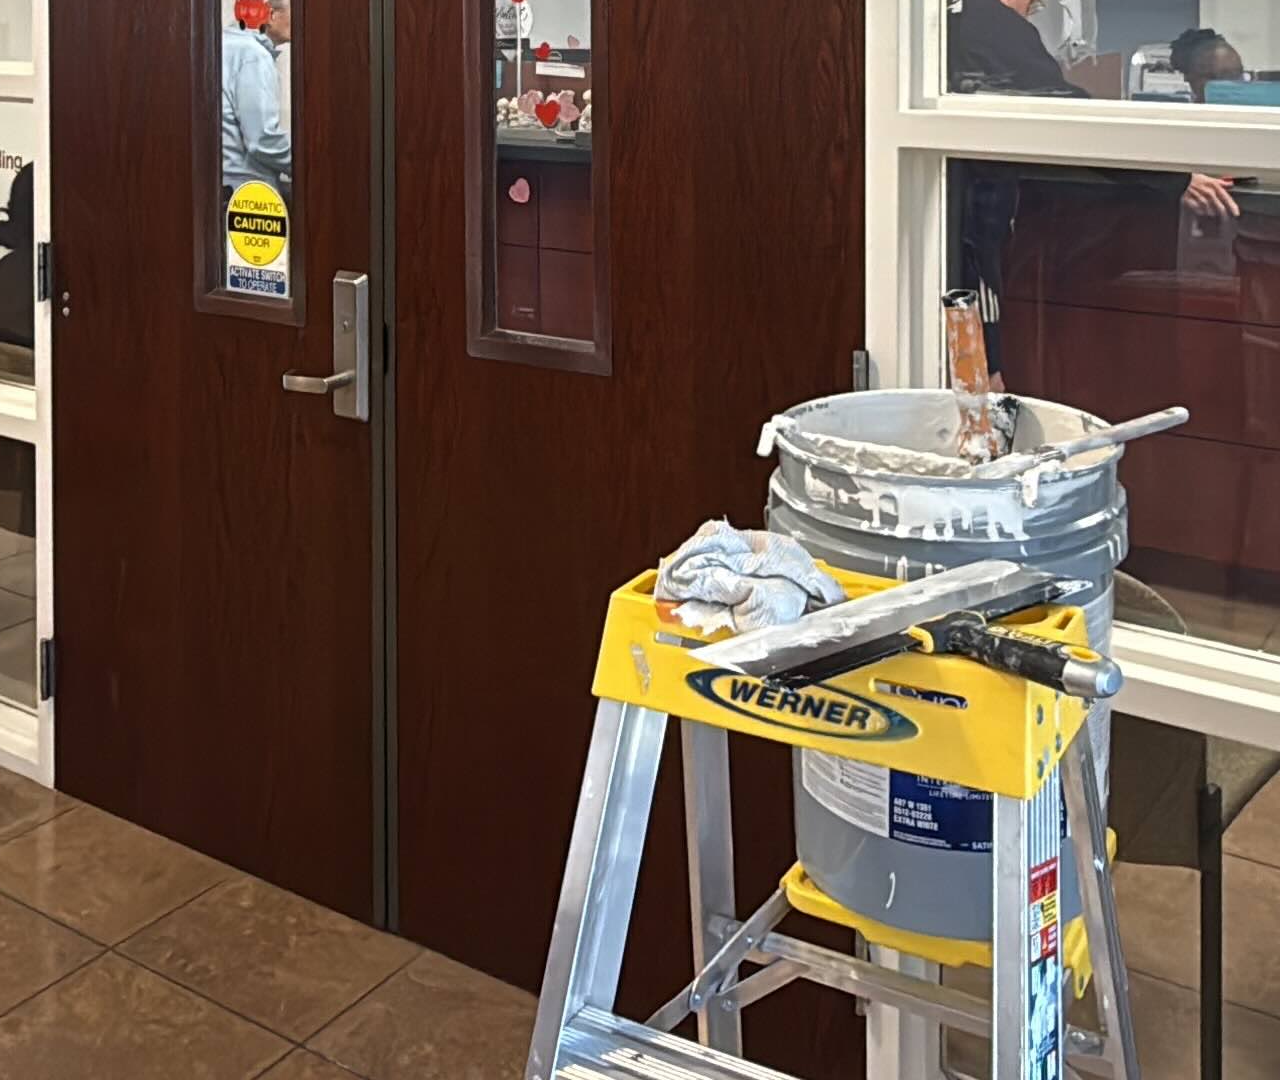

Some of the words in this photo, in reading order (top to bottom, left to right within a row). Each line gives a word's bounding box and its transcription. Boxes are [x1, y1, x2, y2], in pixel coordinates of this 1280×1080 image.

[232, 199, 282, 213] AUTOMATIC
[233, 216, 281, 233] CAUTION
[244, 235, 270, 248] DOOR
[230, 266, 261, 280] ACTIVATE
[729, 678, 872, 731] WERNER
